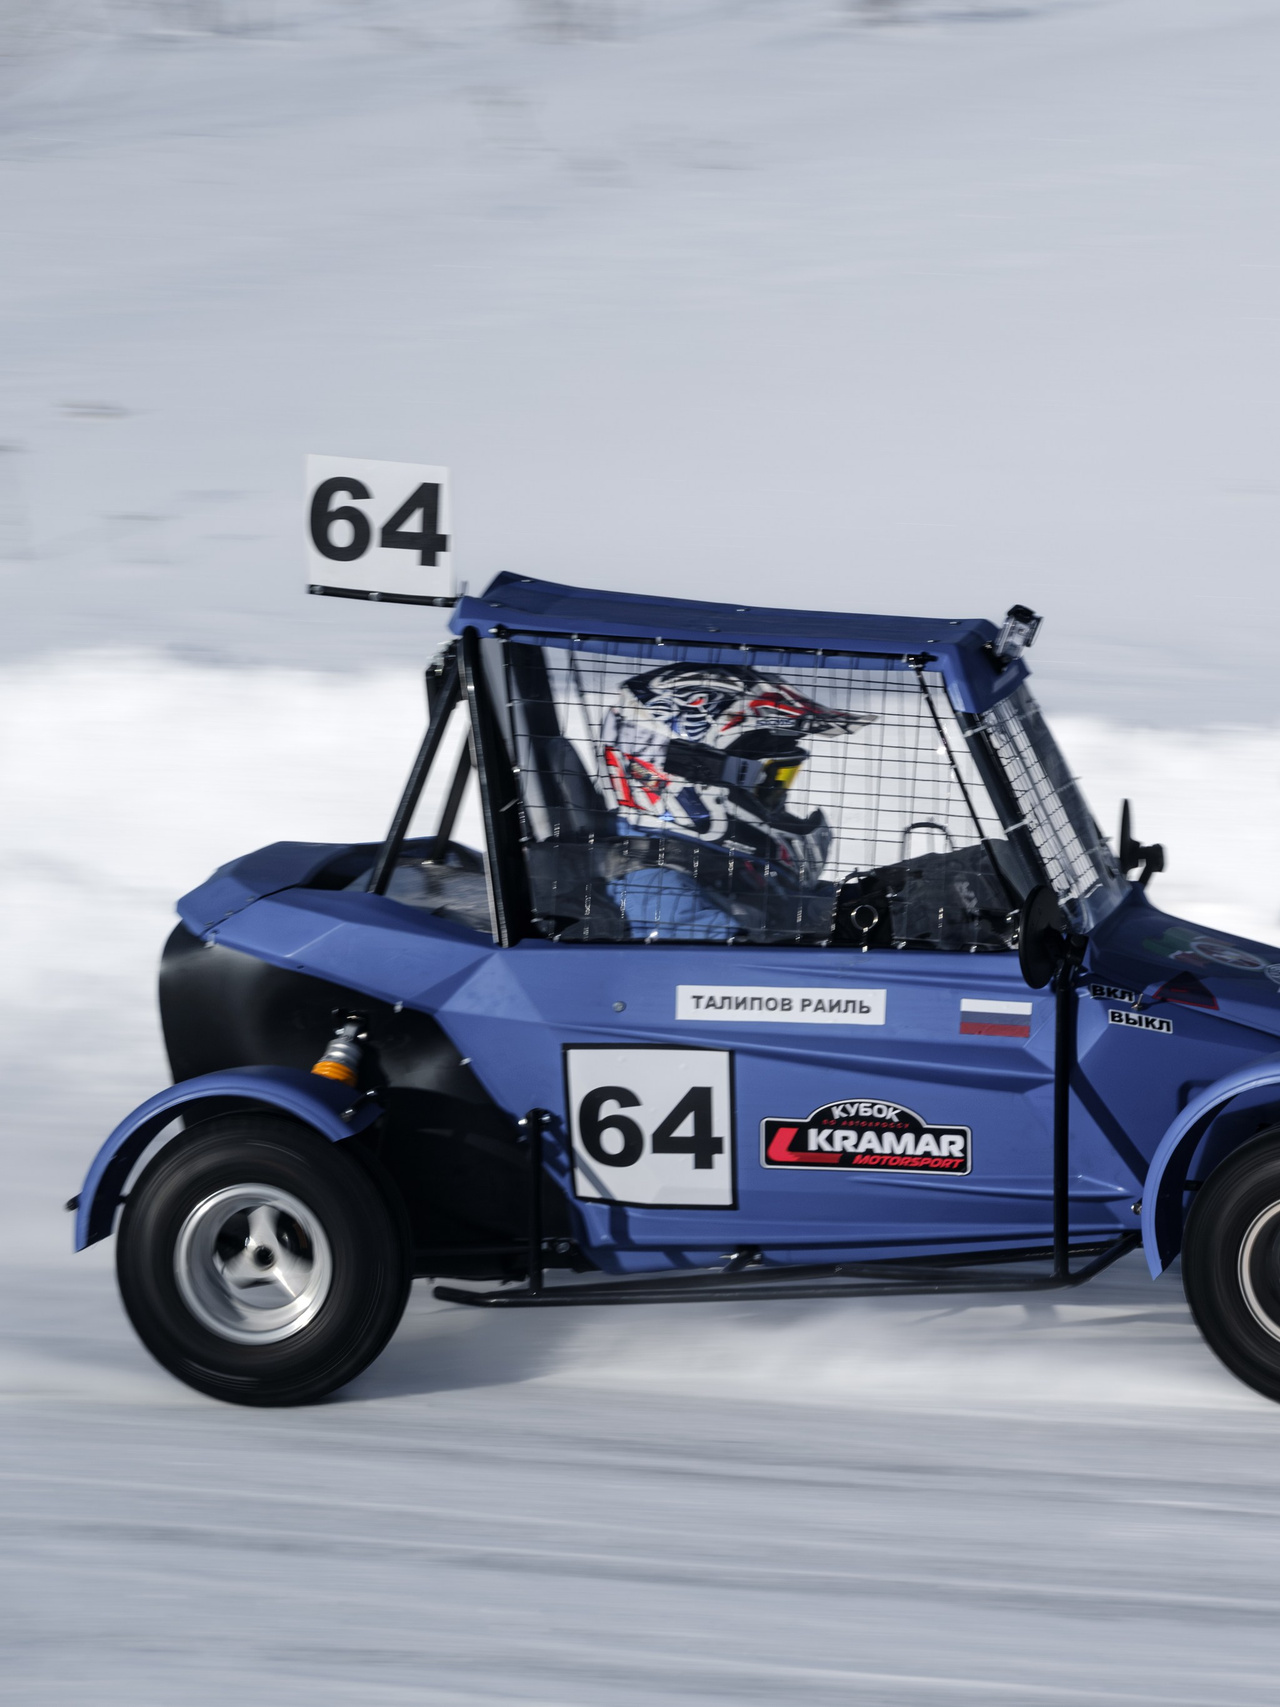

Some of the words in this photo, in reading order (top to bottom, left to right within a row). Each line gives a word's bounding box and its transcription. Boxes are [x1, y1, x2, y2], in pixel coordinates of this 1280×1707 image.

[308, 476, 451, 567] 64
[1091, 984, 1134, 1002] ВКЛ
[692, 995, 793, 1012] ТАЛИПОВ
[801, 998, 872, 1014] РАИЛЬ
[1110, 1010, 1171, 1032] ВЫКЛ
[831, 1103, 901, 1122] КУБОК
[579, 1086, 723, 1169] 64
[807, 1128, 965, 1158] KRAMAR
[852, 1154, 965, 1169] MOTORSPORT
